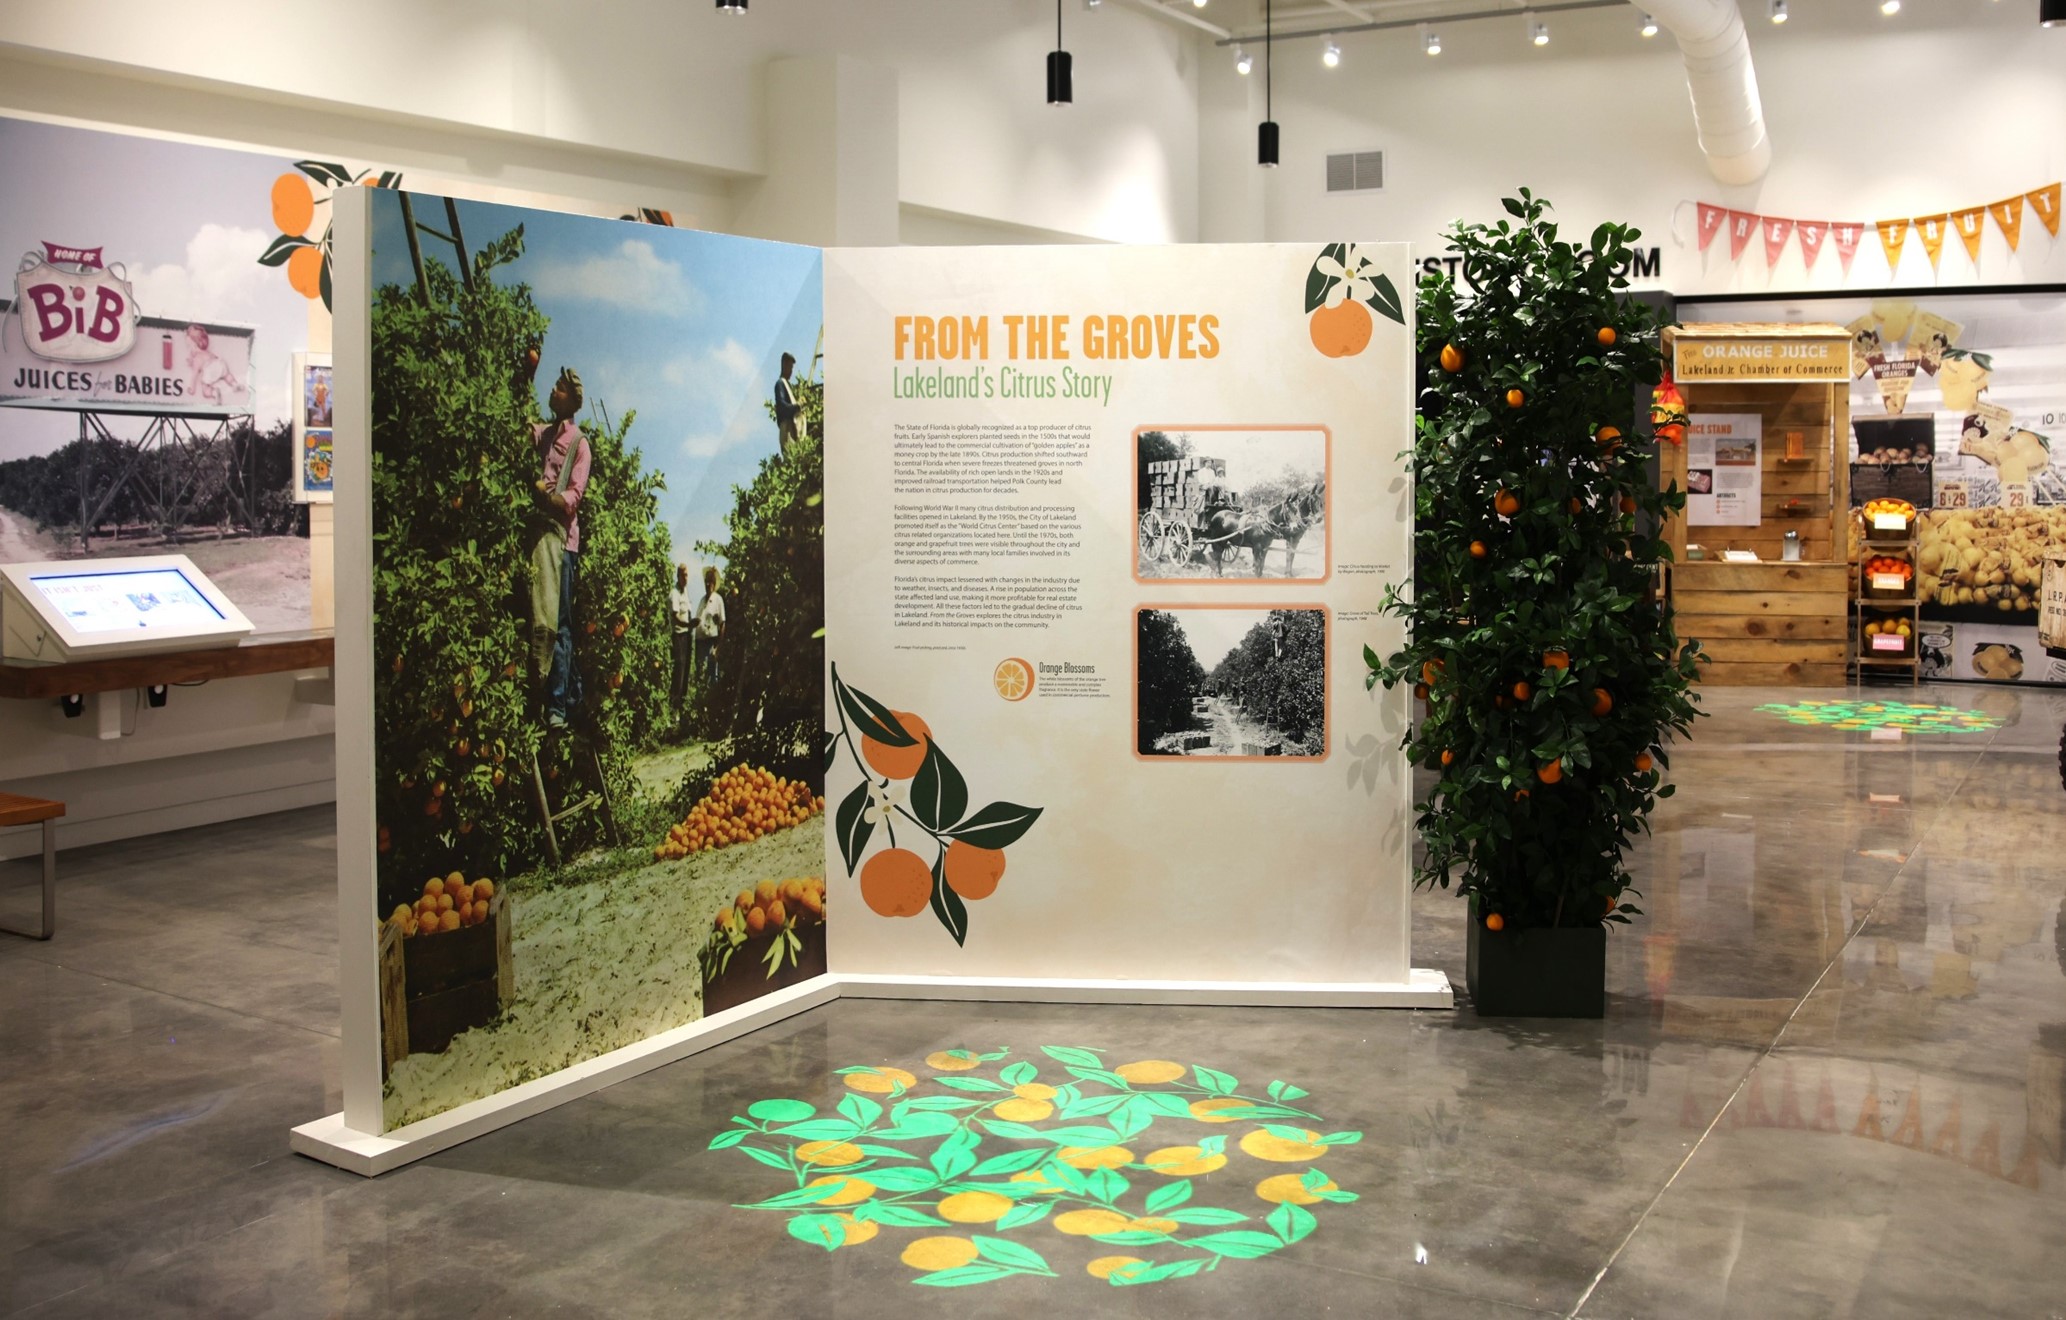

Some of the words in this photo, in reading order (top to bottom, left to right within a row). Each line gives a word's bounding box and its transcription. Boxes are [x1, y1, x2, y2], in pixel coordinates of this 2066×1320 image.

[1704, 209, 1852, 244] FRESH
[1889, 192, 2052, 244] FRUIT
[54, 248, 82, 261] HOME
[82, 250, 96, 262] OF
[894, 316, 988, 360] FROM
[1002, 315, 1070, 360] THE
[1083, 314, 1220, 360] GROVES
[1703, 345, 1773, 358] ORANGE
[1780, 345, 1828, 358] JUICE
[1682, 364, 1724, 375] Lakeland
[1740, 364, 1780, 374] Chamber
[1784, 366, 1791, 374] of
[1796, 364, 1843, 374] Commerce
[1874, 364, 1891, 372] FRESH
[1892, 362, 1916, 370] FLORIDA
[14, 368, 92, 390] JUICES
[115, 374, 184, 396] BABIES
[894, 366, 994, 399] Lakeland's
[1000, 366, 1056, 399] Citrus
[1062, 366, 1112, 408] Story
[1688, 424, 1704, 434] UICE
[1707, 424, 1732, 434] STAND
[1953, 492, 1966, 506] 29
[2010, 492, 2024, 507] 29
[1039, 662, 1062, 676] Orange
[1064, 662, 1095, 674] Blossoms
